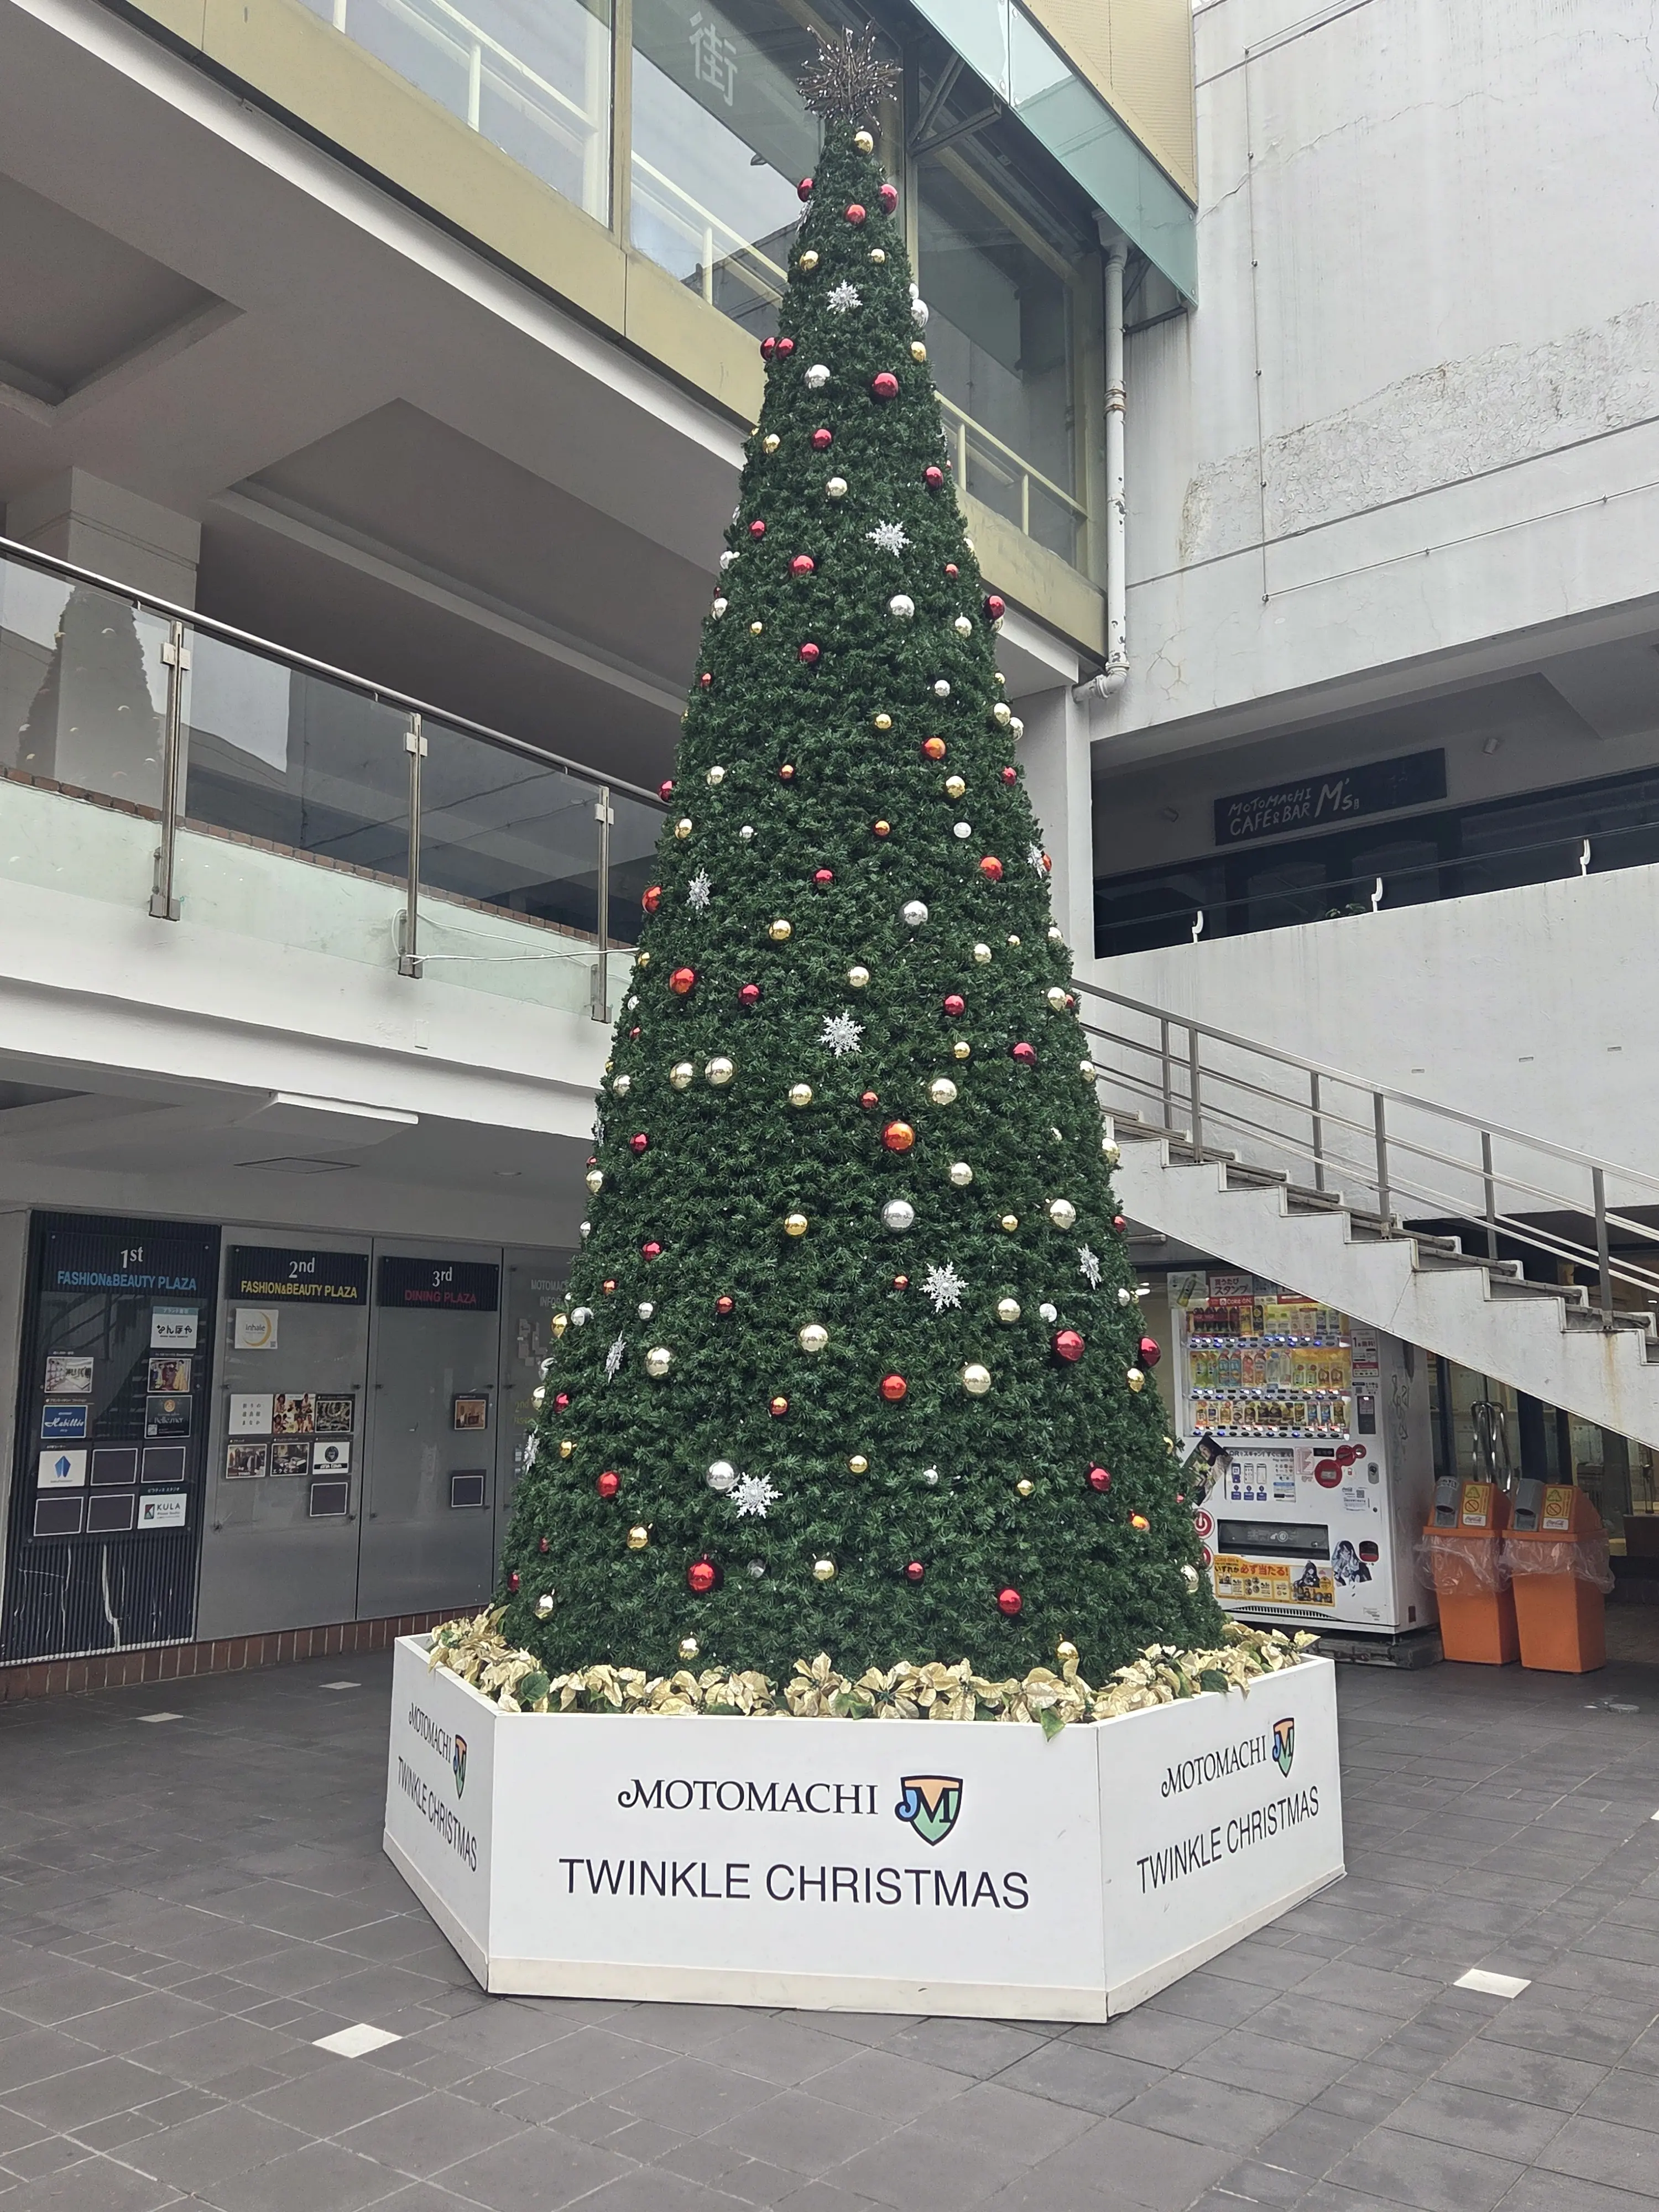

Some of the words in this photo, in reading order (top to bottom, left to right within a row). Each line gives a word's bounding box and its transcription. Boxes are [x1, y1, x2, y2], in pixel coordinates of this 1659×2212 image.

[688, 11, 738, 107] 街
[1228, 787, 1311, 817] MOTOMACHI
[120, 1246, 143, 1268] 1st
[288, 1258, 315, 1278] 2nd
[57, 1271, 156, 1288] FASHION&BEAUTY
[158, 1275, 196, 1291] PLAZA
[432, 1267, 452, 1287] 3rd
[531, 1279, 568, 1291] MOTOMAC
[241, 1280, 322, 1296] FASHION&BEAUTY
[324, 1285, 357, 1298] PLAZA
[404, 1290, 441, 1302] DINING
[444, 1292, 477, 1303] PLAZA
[1215, 1285, 1249, 1296] スタンプ
[156, 1503, 181, 1511] KULA
[408, 1701, 451, 1765] MOTOMACHI
[1161, 1735, 1267, 1798] MOTOMACHI
[617, 1778, 879, 1814] MOTOMACHI
[398, 1755, 427, 1817] TWINKLE
[428, 1791, 477, 1872] CHRISTMAS
[1136, 1827, 1222, 1894] TWINKLE
[1227, 1785, 1319, 1854] CHRISTMAS
[559, 1858, 751, 1899] TWINKLE
[766, 1864, 1030, 1910] CHRISTMAS
